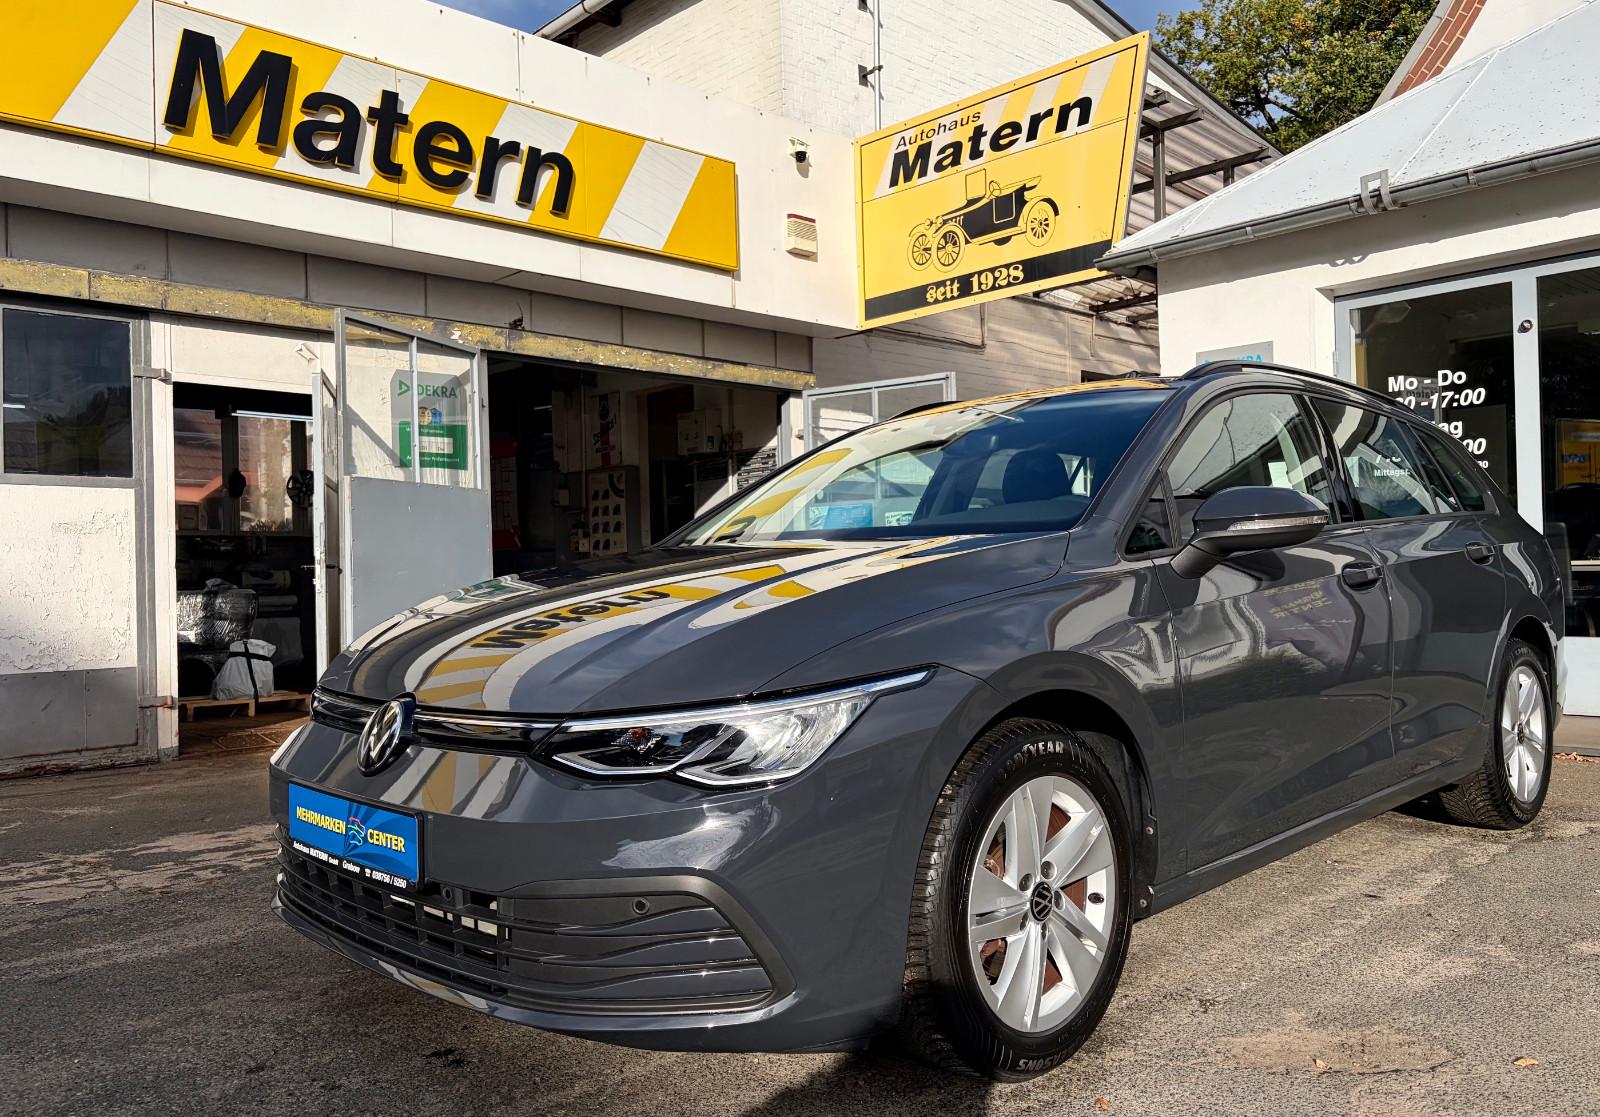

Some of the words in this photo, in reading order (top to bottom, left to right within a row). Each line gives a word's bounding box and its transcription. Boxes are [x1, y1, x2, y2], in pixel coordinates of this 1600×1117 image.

[162, 28, 574, 215] Matern
[895, 111, 982, 150] Autohaus
[888, 96, 1093, 189] Matern
[926, 278, 960, 303] seit
[970, 264, 1024, 294] 1928
[417, 384, 458, 398] DEKRA
[1387, 375, 1418, 392] Mo
[1437, 369, 1467, 386] Do
[296, 806, 346, 835] MEHRMARKEN
[367, 828, 406, 853] CENTER
[342, 860, 361, 874] Grabow
